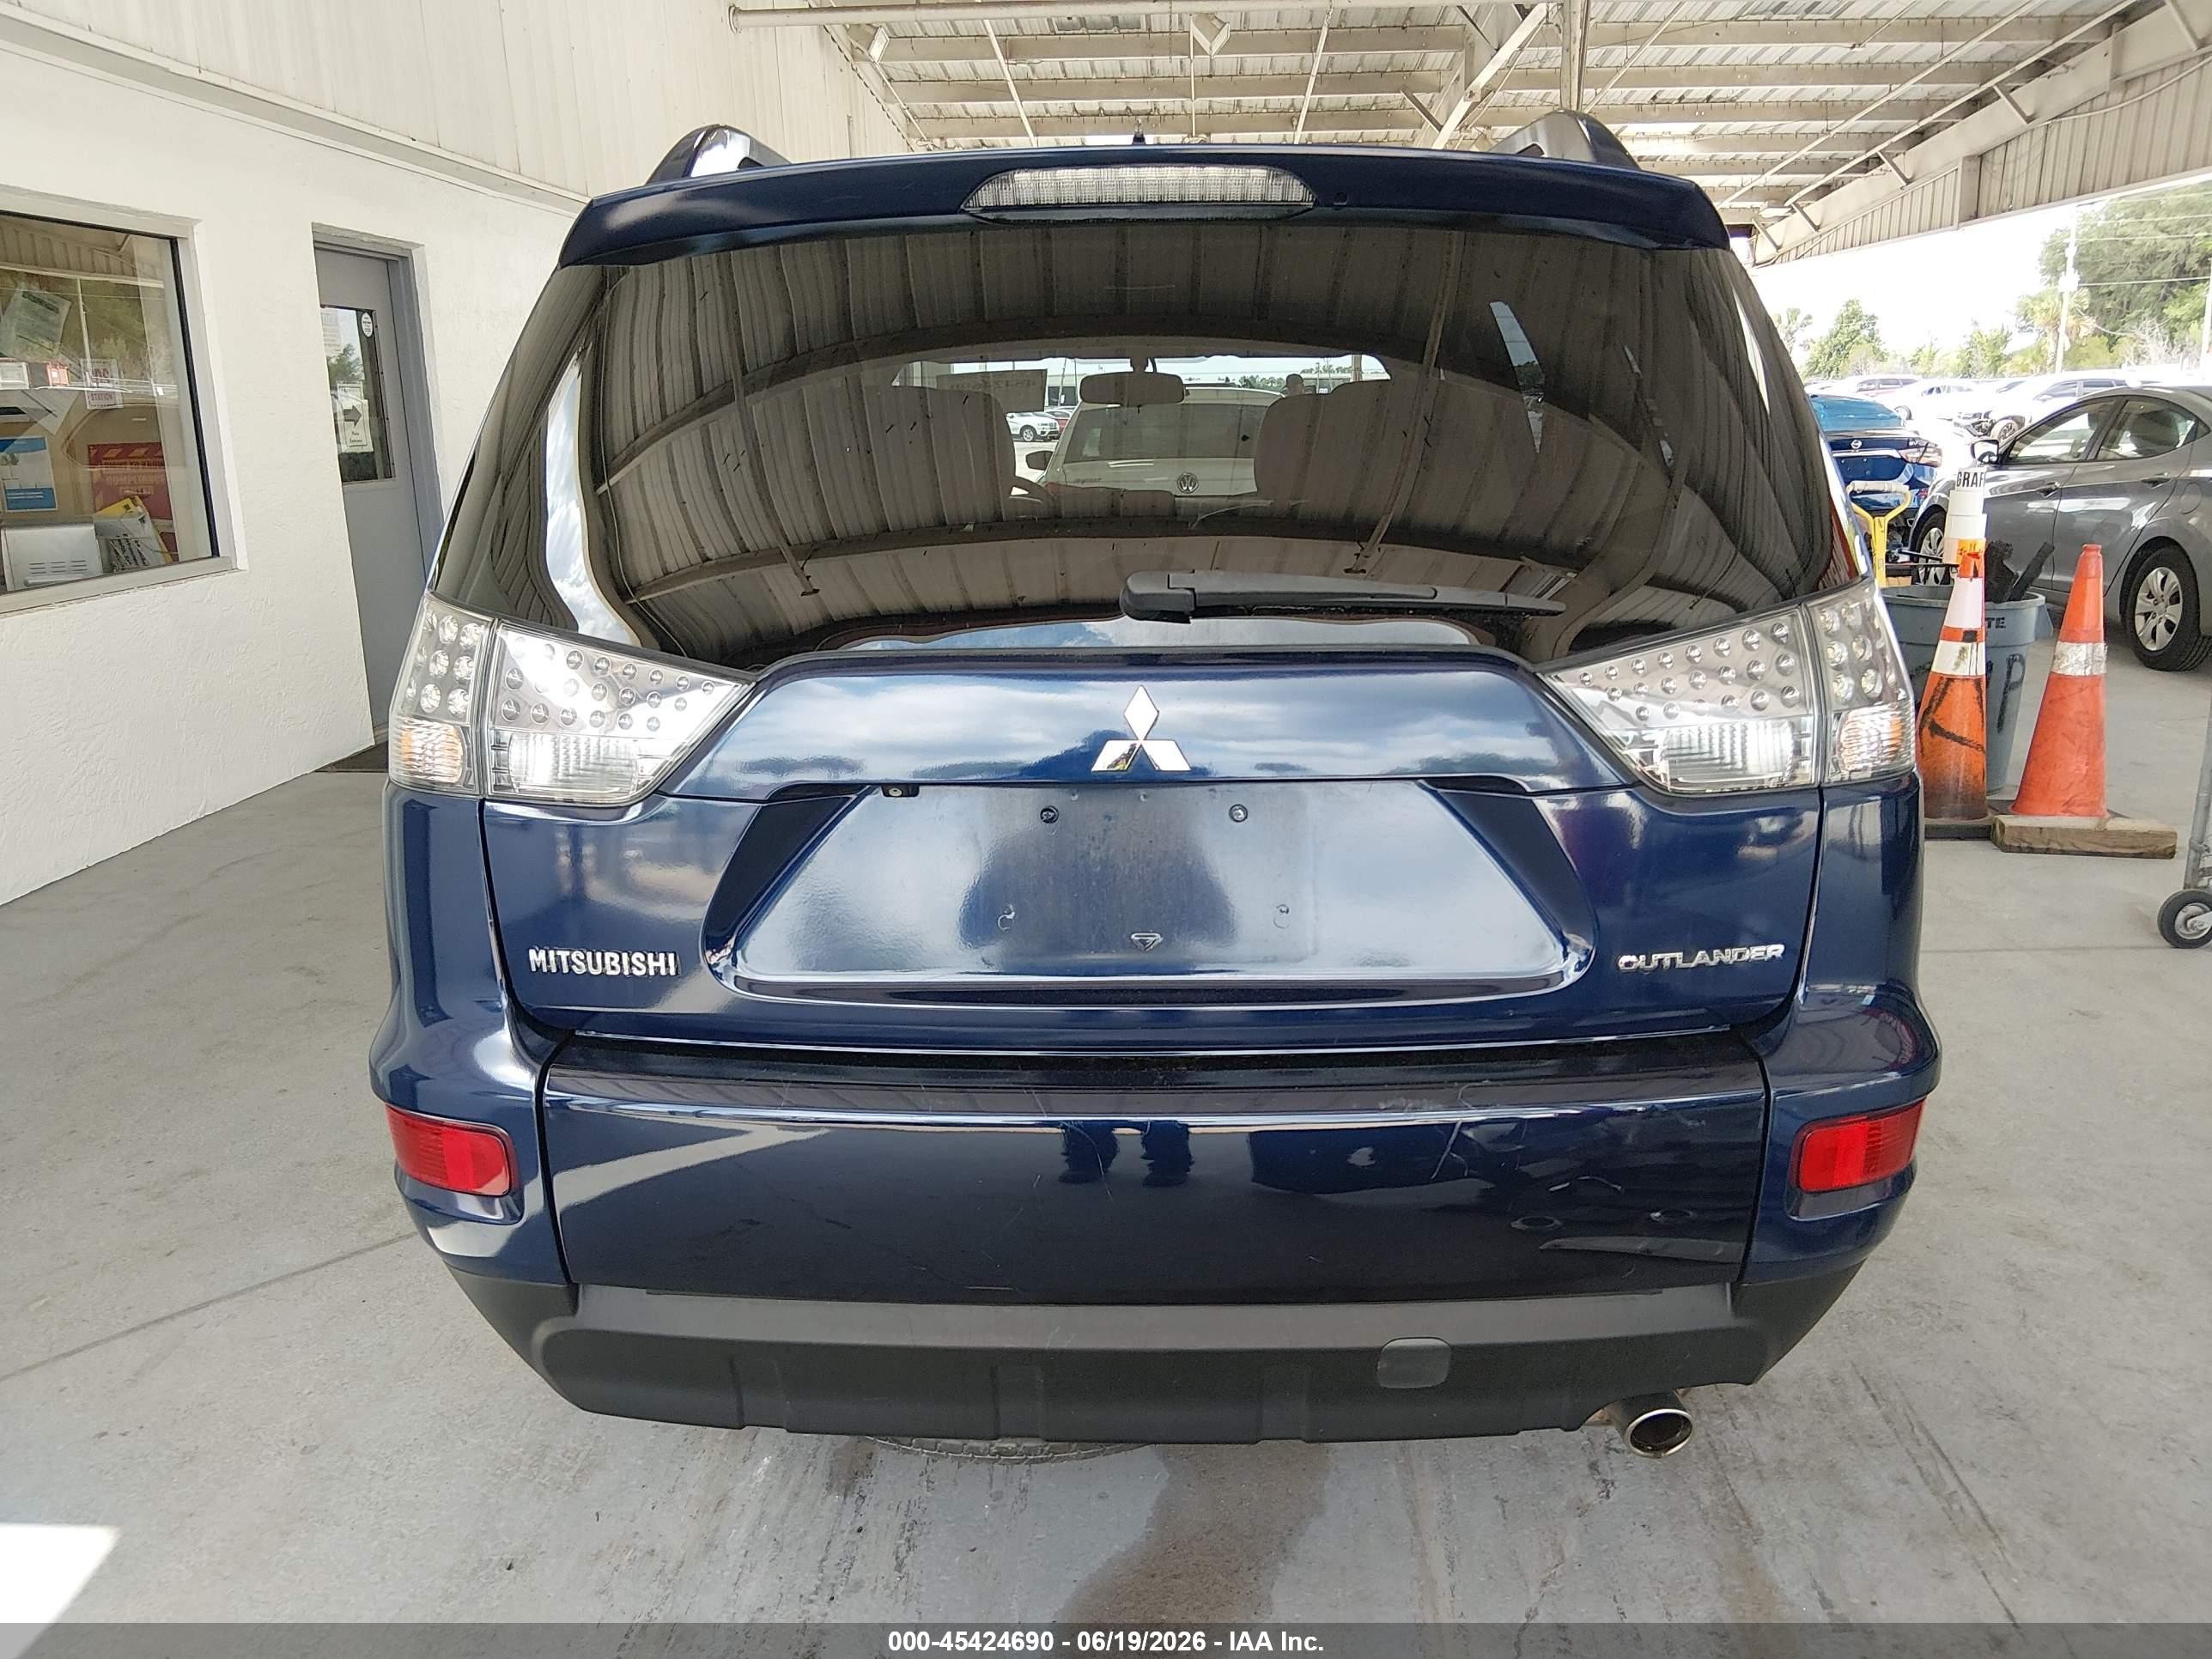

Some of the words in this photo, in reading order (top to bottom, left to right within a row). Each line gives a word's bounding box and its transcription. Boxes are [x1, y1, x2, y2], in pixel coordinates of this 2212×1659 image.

[1956, 471, 1986, 488] GRAF
[528, 948, 678, 976] MITSUBISHI
[1618, 944, 1785, 972] OUTLANDER
